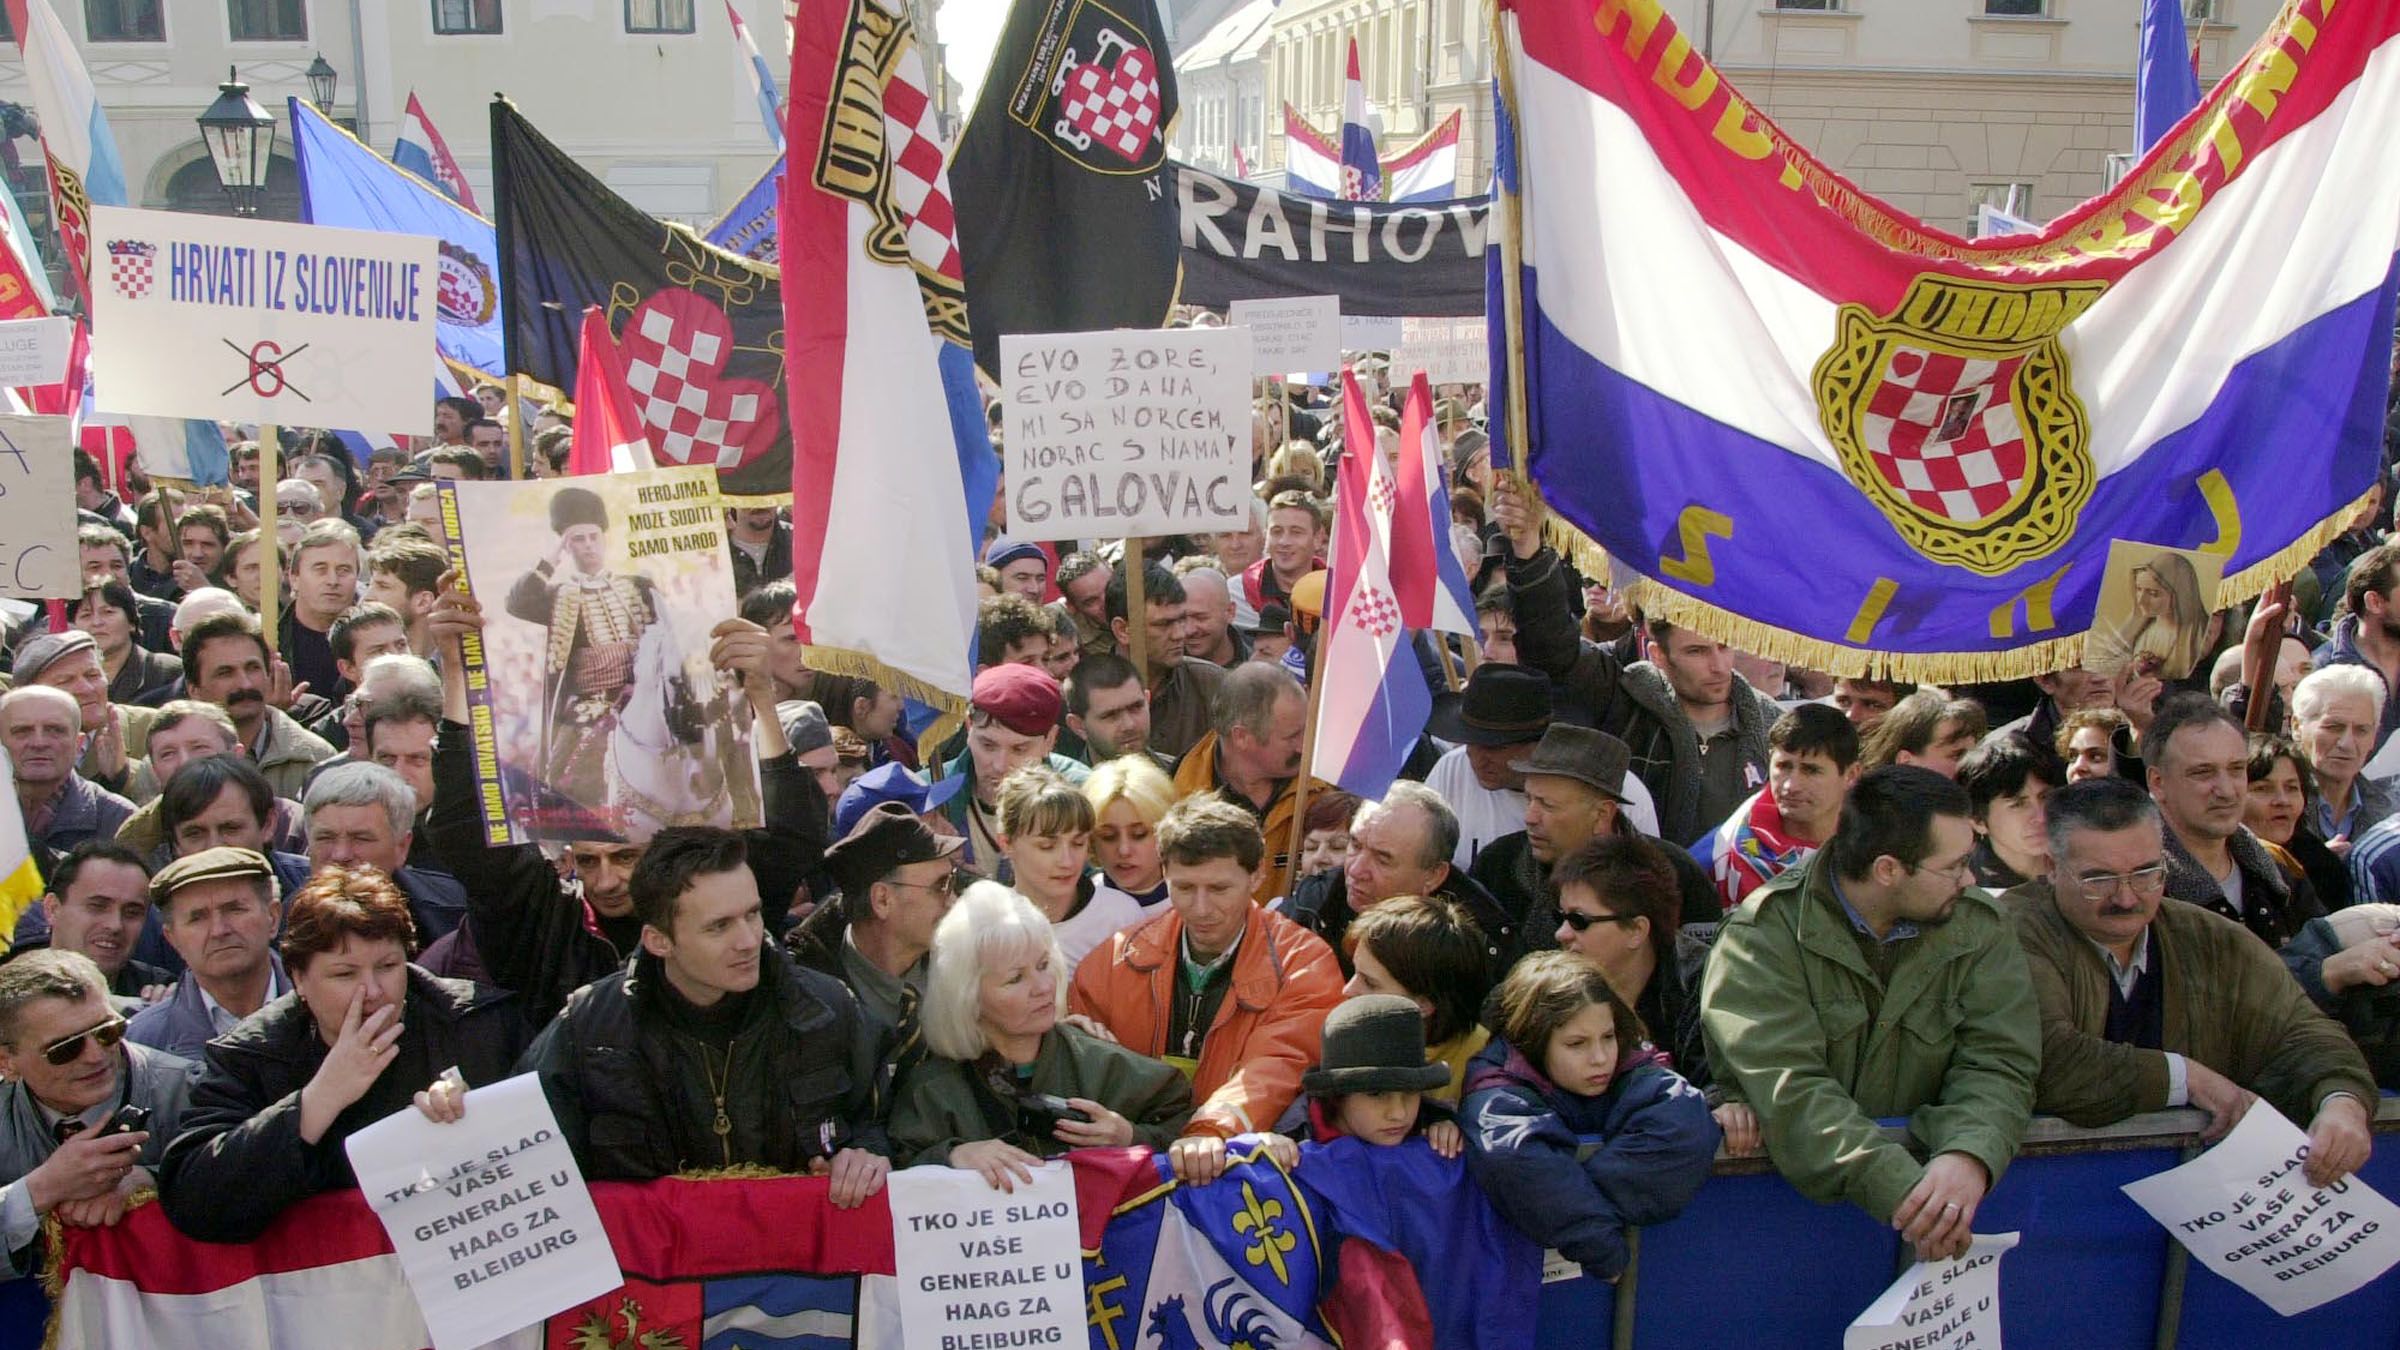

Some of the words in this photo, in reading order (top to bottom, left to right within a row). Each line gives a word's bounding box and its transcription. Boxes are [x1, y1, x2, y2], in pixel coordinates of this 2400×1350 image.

[171, 241, 255, 307] HRVATI
[265, 249, 287, 310] IZ
[295, 252, 420, 322] SLOVENIJE
[249, 340, 285, 397] 6
[1018, 349, 1079, 378] EVO
[1110, 347, 1217, 374] ZORE,
[1016, 379, 1086, 404] EVO
[1022, 414, 1046, 441] MI
[1061, 410, 1095, 434] SA
[1112, 406, 1225, 433] NORCEM,
[1023, 442, 1105, 470] NORAC
[1122, 439, 1146, 462] S
[1160, 434, 1237, 465] NAMA!
[637, 480, 709, 504] HEROJIMA
[1016, 470, 1239, 523] GALOVAC
[439, 488, 461, 541] NORCA
[628, 508, 668, 533] MOŽE
[669, 505, 714, 527] SUDITI
[628, 537, 669, 559] SAMO
[672, 531, 718, 553] NAROD
[467, 669, 488, 690] NE
[471, 705, 498, 779] HRVATSKU
[481, 782, 505, 821] DAMO
[489, 823, 510, 844] NE
[447, 1160, 478, 1180] JE
[486, 1129, 552, 1162] SLAO
[414, 1180, 546, 1243] GENERALE
[551, 1170, 570, 1188] U
[2179, 1210, 2226, 1234] TKO
[2231, 1191, 2257, 1215] JE
[2257, 1144, 2311, 1189] SLAO
[908, 1212, 958, 1233] TKO
[965, 1209, 994, 1228] JE
[1005, 1201, 1070, 1224] SLAO
[2224, 1190, 2331, 1263] GENERALE
[2329, 1179, 2350, 1197] U
[2239, 1187, 2296, 1233] VAŠE
[448, 1220, 520, 1262] HAAG
[524, 1206, 561, 1231] ZA
[959, 1235, 1023, 1259] VAŠE
[2260, 1232, 2323, 1267] HAAG
[2320, 1209, 2356, 1235] ZA
[2273, 1219, 2381, 1282] BLEIBURG
[453, 1229, 578, 1291] BLEIBURG
[920, 1265, 1047, 1292] GENERALE
[1055, 1262, 1072, 1280] U
[1941, 1254, 1995, 1286] SLAO
[945, 1300, 1011, 1321] HAAG
[1018, 1296, 1052, 1316] ZA
[1977, 1296, 1991, 1312] U
[941, 1326, 1062, 1350] BLEIBURG
